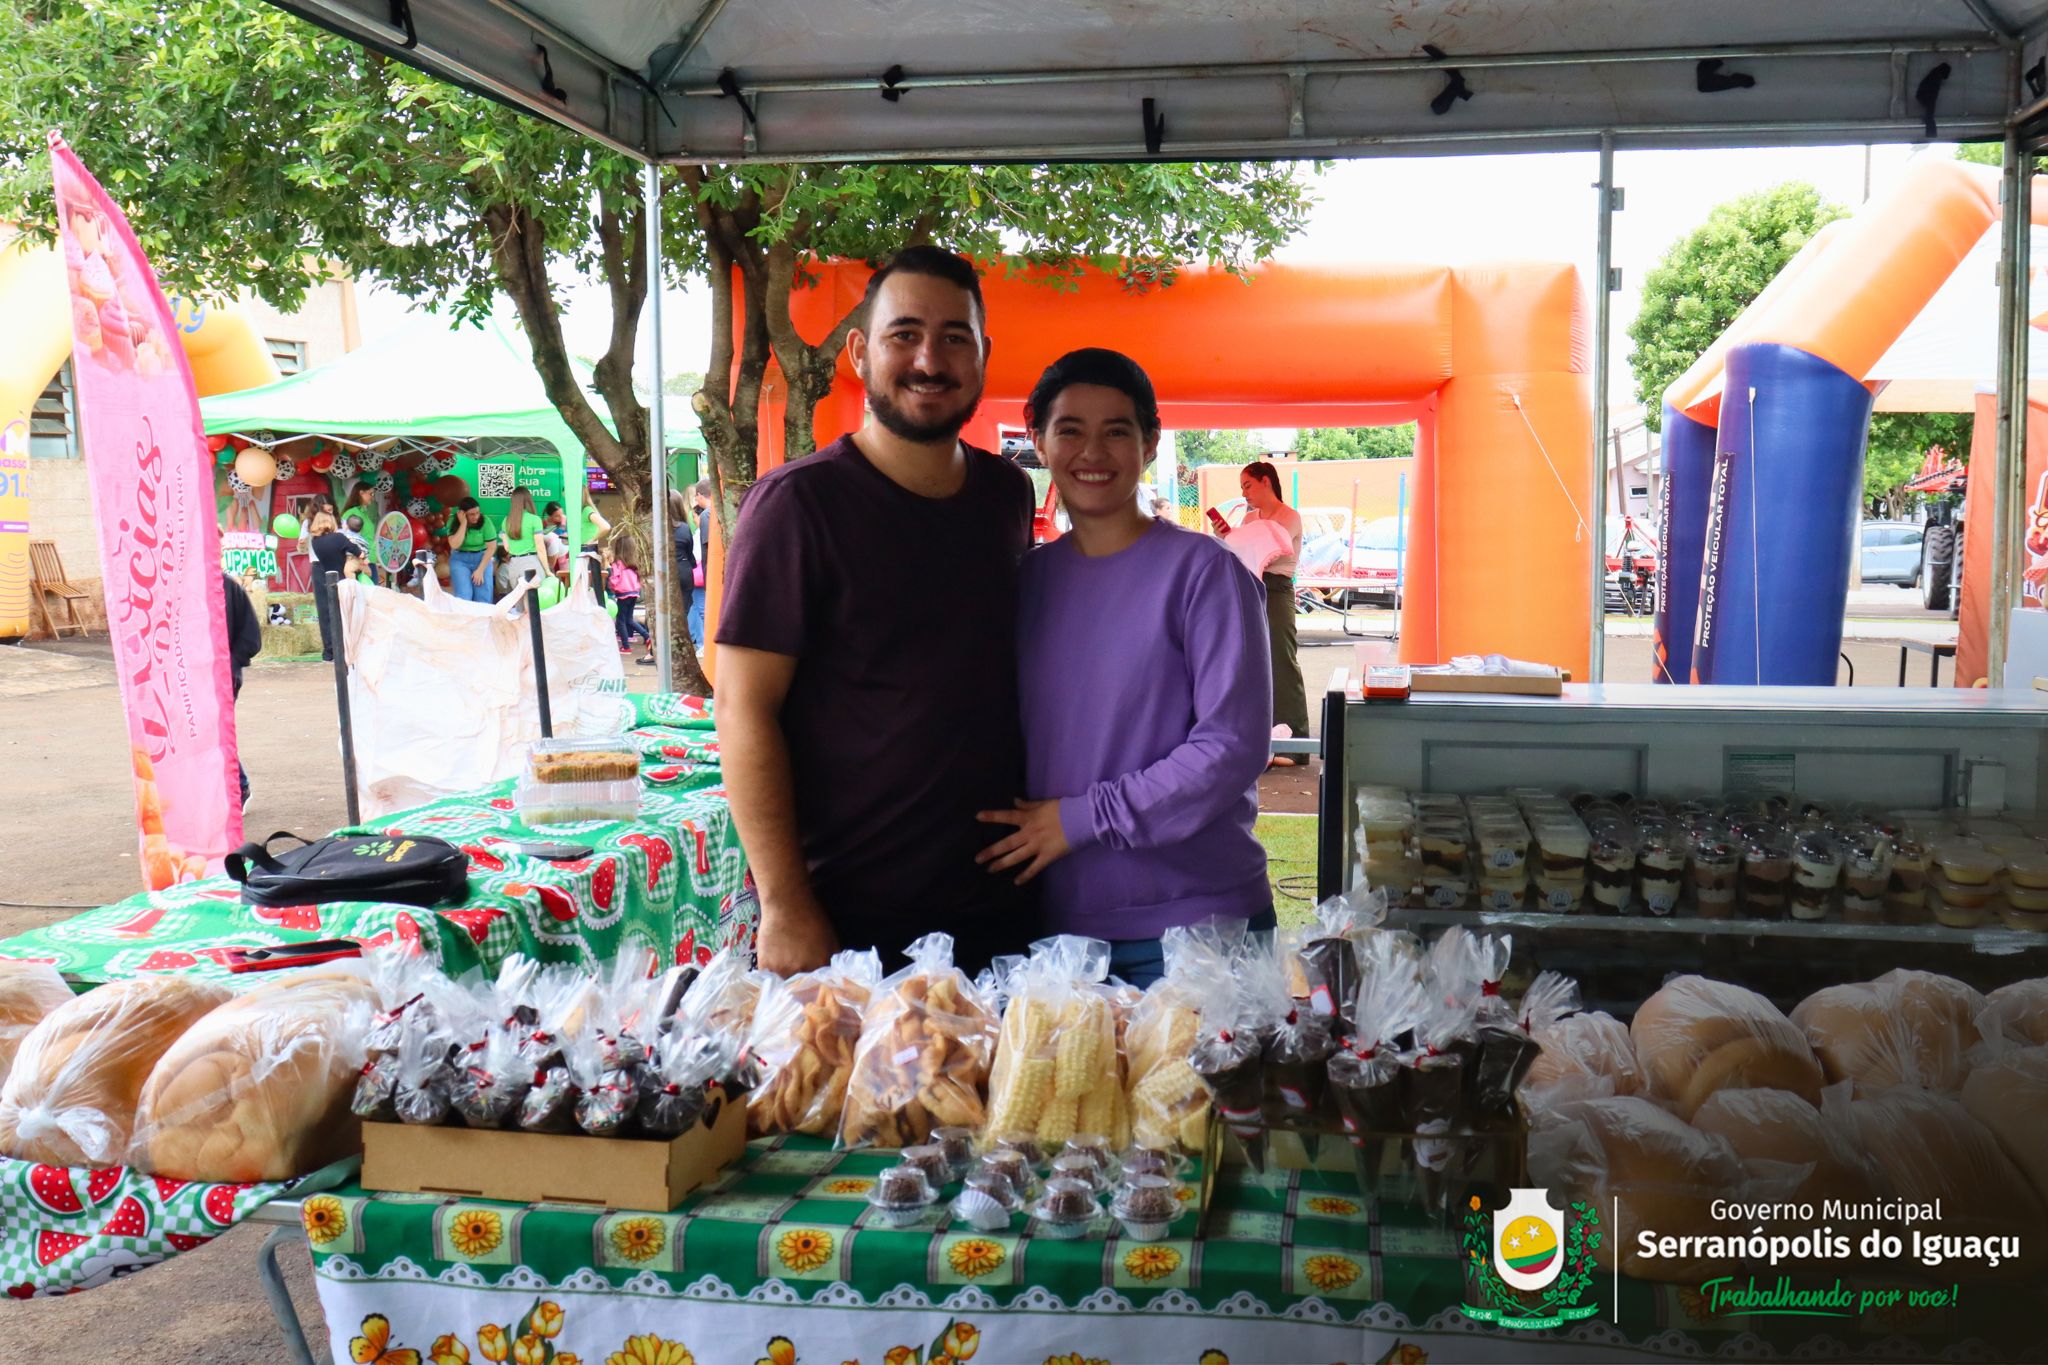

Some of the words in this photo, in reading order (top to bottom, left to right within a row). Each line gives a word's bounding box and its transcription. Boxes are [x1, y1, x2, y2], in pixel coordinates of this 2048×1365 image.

[518, 465, 546, 475] Abra
[518, 478, 540, 486] sua
[529, 488, 551, 497] onta
[1662, 507, 1670, 558] VEICULAR
[1702, 574, 1716, 648] PROTEÇÃO
[1710, 504, 1724, 573] VEICULAR
[1717, 459, 1729, 503] TOTAL
[1660, 559, 1668, 613] PROTEÇÃO
